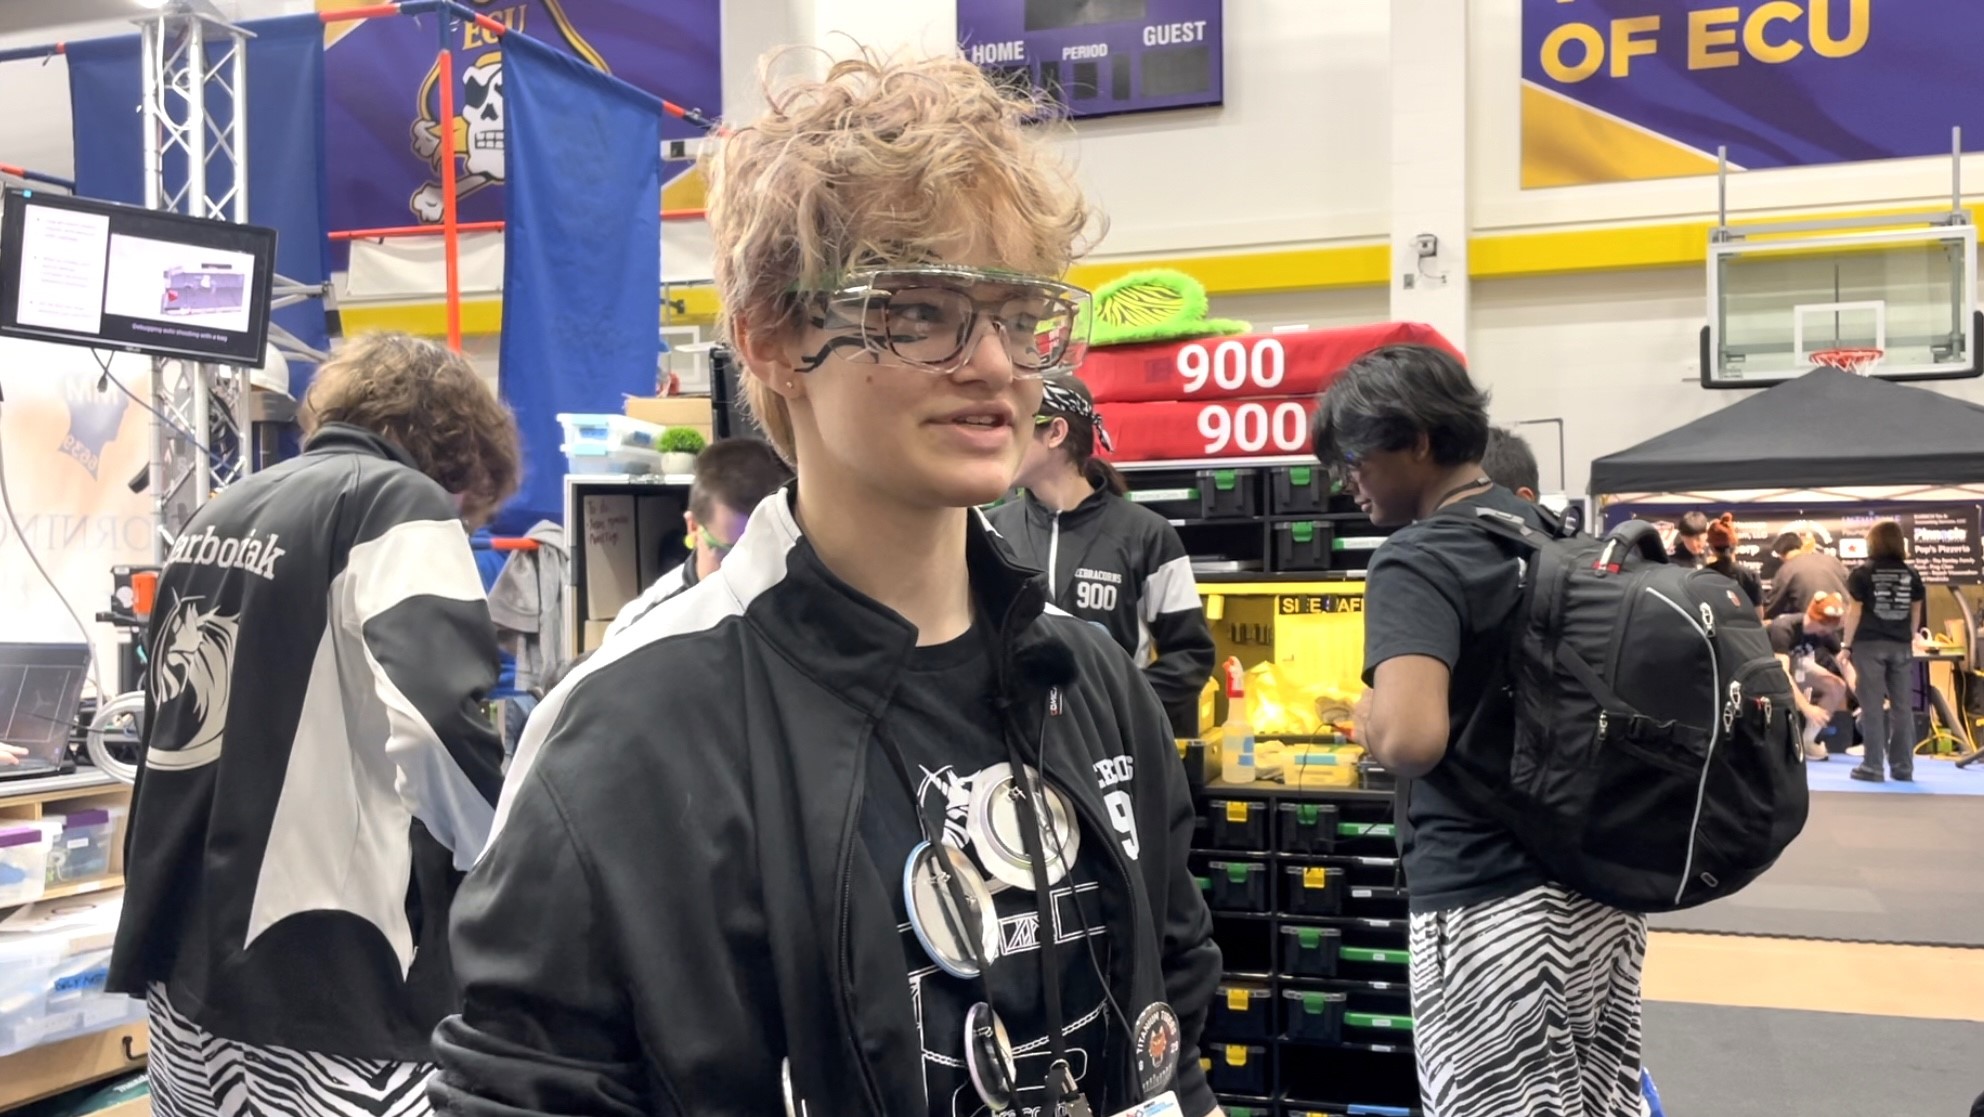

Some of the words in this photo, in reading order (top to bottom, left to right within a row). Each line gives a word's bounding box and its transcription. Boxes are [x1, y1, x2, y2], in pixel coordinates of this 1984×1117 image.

[462, 4, 527, 50] ECU
[1143, 21, 1207, 47] GUEST
[1540, 15, 1661, 83] OF
[1688, 0, 1870, 70] ECU
[972, 40, 1024, 64] HOME
[1062, 43, 1108, 61] PERIOD
[1177, 339, 1285, 393] 900
[1197, 402, 1307, 454] 900
[165, 525, 286, 580] arboiak
[1914, 544, 1937, 555] Pop's
[1938, 544, 1970, 553] Pizzeria
[1076, 581, 1117, 611] 900
[1135, 1011, 1160, 1055] TITANIUM
